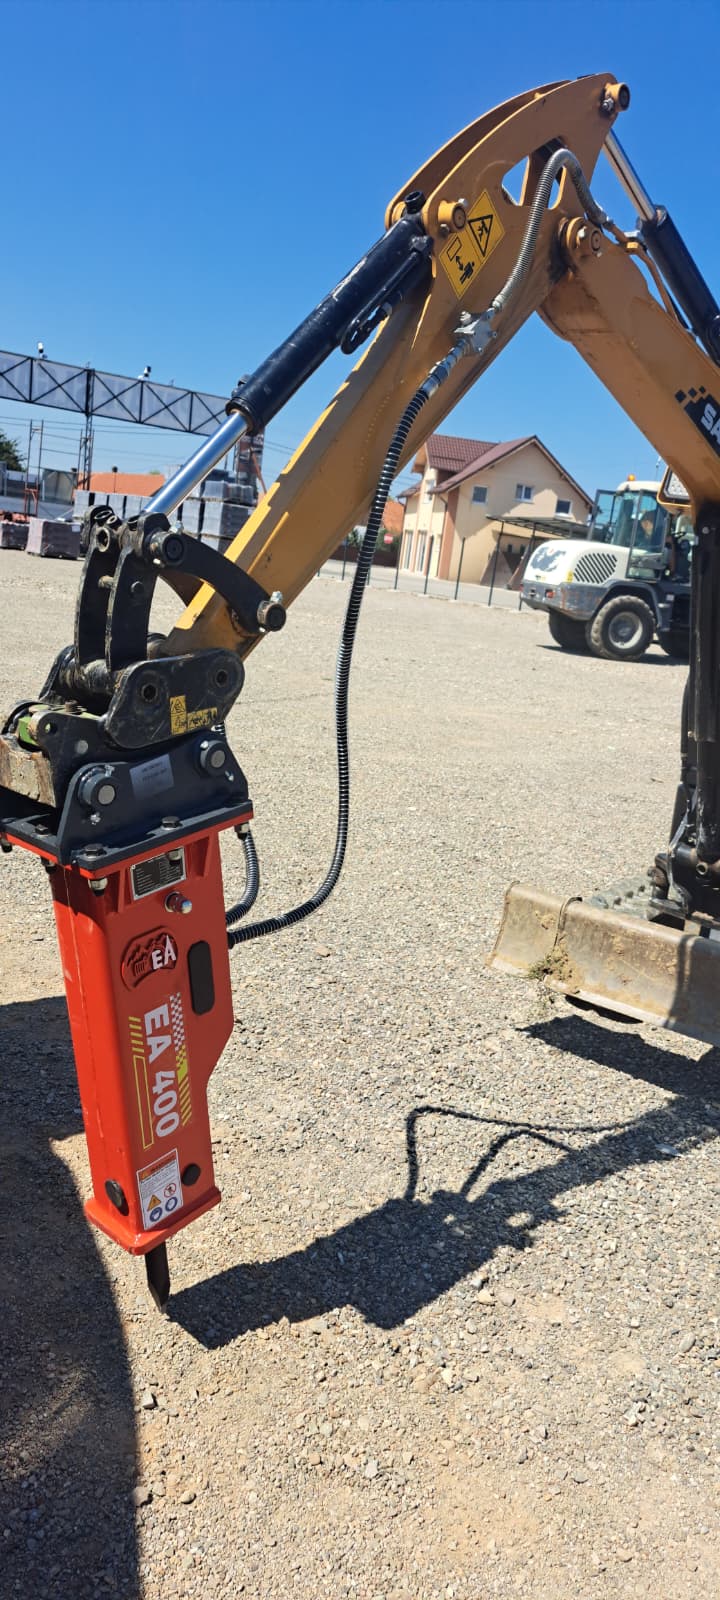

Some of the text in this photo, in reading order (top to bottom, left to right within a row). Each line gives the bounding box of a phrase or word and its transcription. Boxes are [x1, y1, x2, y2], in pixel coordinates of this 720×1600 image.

[152, 935, 177, 970] EA
[144, 1004, 172, 1063] EA
[152, 1070, 180, 1137] 400
